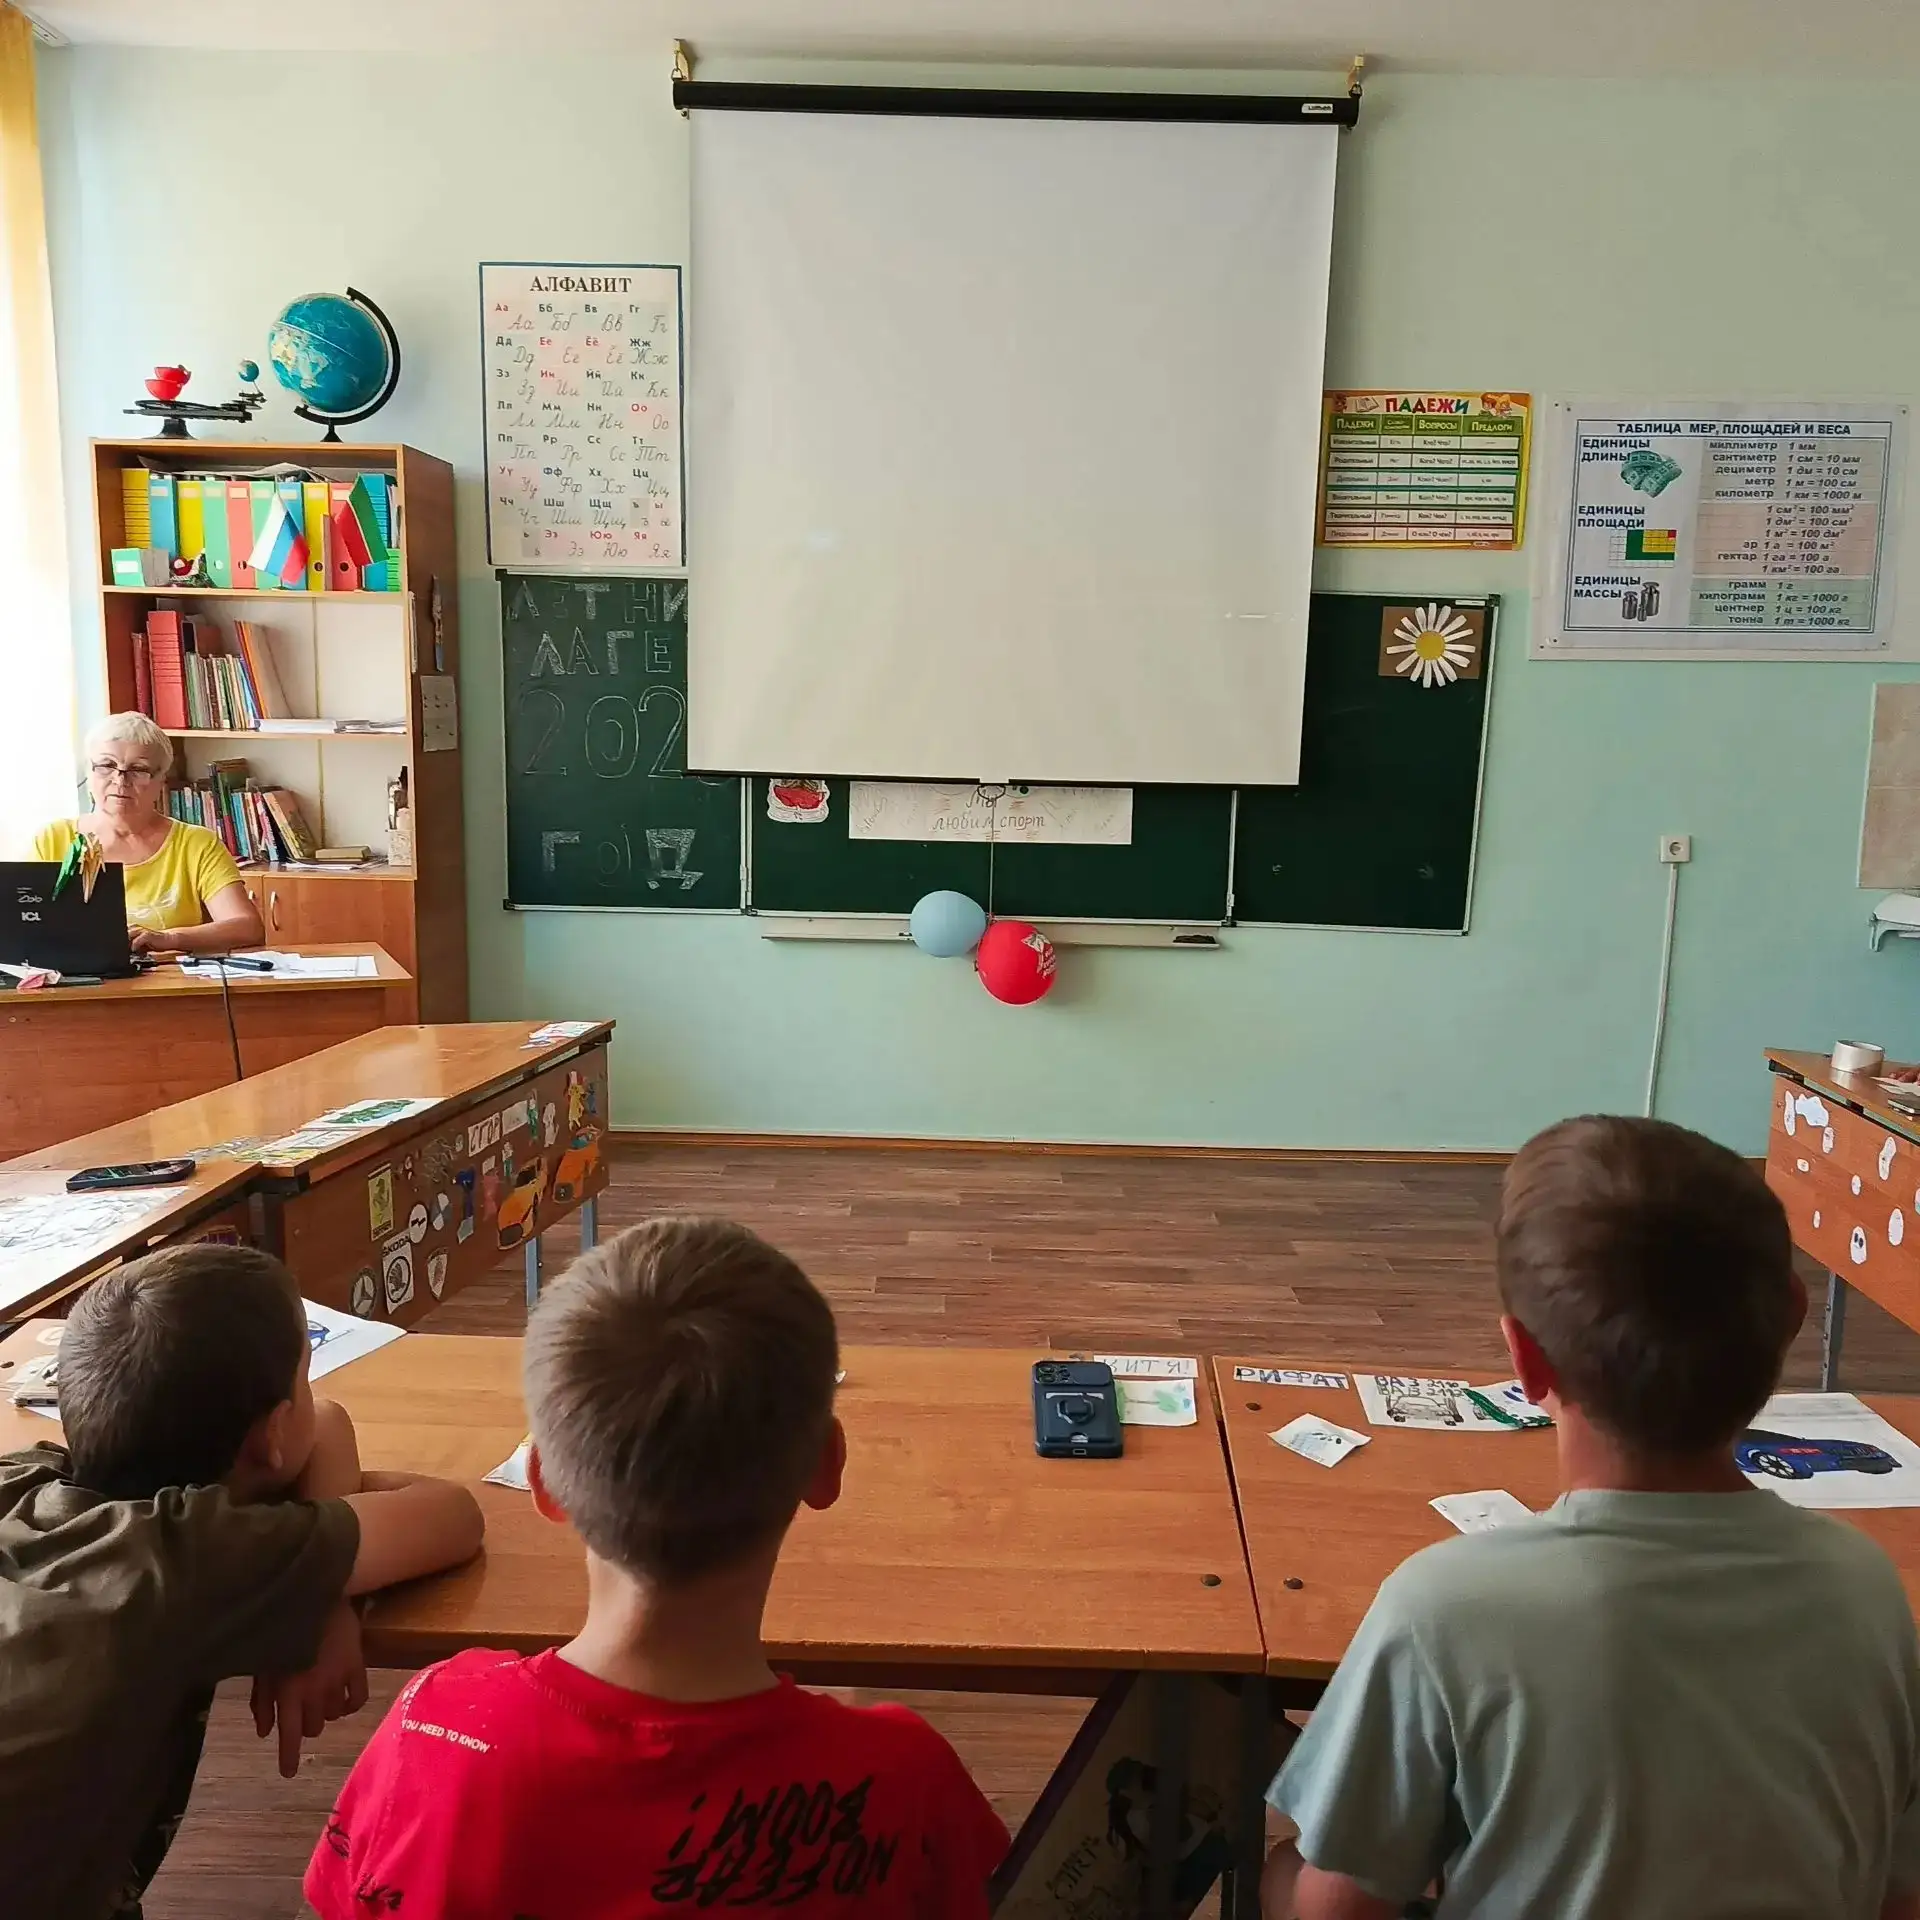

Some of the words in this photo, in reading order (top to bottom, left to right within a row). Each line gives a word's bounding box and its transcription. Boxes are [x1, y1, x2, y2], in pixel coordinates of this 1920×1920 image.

[529, 277, 632, 293] АЛФАВИТ
[1386, 398, 1470, 414] ПАДЕЖИ
[1617, 424, 1681, 433] ТАБЛИЦА
[1690, 424, 1719, 435] МЕР,
[1723, 423, 1800, 435] ПЛОЩАДЕЙ
[1805, 425, 1813, 433] И
[1818, 425, 1850, 434] ВЕСА
[1583, 440, 1650, 449] ЕДИНИЦЫ
[1710, 441, 1777, 449] миллиметр
[1582, 452, 1631, 462] ДЛИНЫ
[1713, 453, 1776, 462] сантиметр
[1716, 466, 1776, 475] дециметр
[1827, 467, 1839, 475] 10
[1745, 478, 1774, 487] метр
[1819, 479, 1838, 487] 100
[1715, 490, 1774, 499] километр
[1824, 491, 1849, 499] 1000
[1579, 506, 1645, 516] ЕДИНИЦЫ
[1578, 519, 1644, 528] ПЛОЩАДИ
[1810, 518, 1828, 526] 100
[1801, 530, 1820, 538] 100
[1718, 553, 1757, 561] гектар
[1763, 553, 1768, 561] 1
[1575, 576, 1640, 586] ЕДИНИЦЫ
[1729, 581, 1766, 589] грамм
[1574, 590, 1621, 598] МАССЫ
[1813, 594, 1838, 602] 1000
[1809, 617, 1834, 625] 1000
[520, 685, 731, 786] 202
[932, 810, 994, 831] любим
[1000, 815, 1047, 832] спорт
[21, 911, 42, 922] ICL
[1236, 1367, 1346, 1390] РИФАТ
[420, 1723, 445, 1737] NEED
[446, 1729, 459, 1742] TO
[459, 1734, 490, 1753] KNOW
